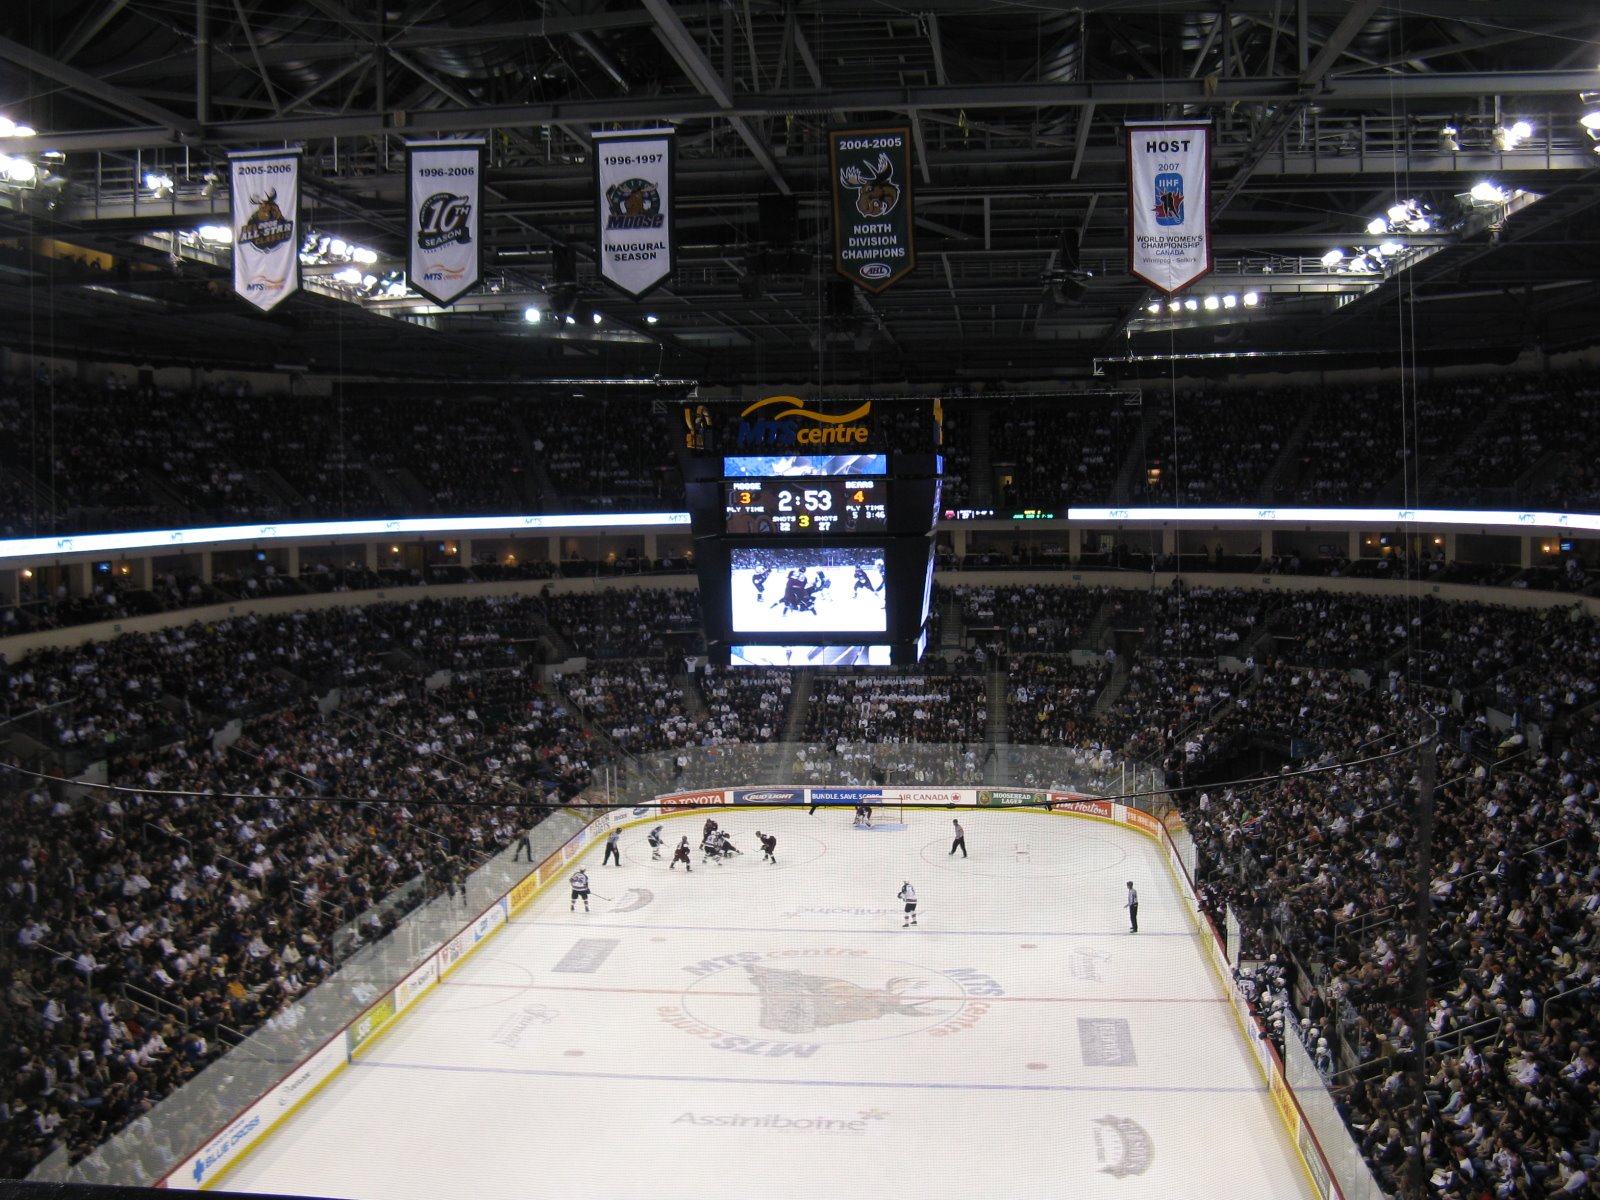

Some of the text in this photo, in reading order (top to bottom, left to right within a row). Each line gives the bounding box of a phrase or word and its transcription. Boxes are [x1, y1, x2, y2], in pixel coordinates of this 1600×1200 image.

[839, 138, 902, 150] 2004-2005
[1146, 140, 1191, 153] HOST
[604, 154, 663, 166] 1996-1997
[238, 164, 292, 176] 2005-2006
[418, 167, 475, 178] 1996-2006
[1158, 163, 1180, 171] 2007
[1158, 179, 1179, 187] IIHF
[853, 224, 892, 234] NORTH
[424, 229, 462, 248] SEASON
[848, 235, 897, 247] DIVISION
[1136, 235, 1165, 243] WORLD
[604, 242, 666, 252] INAUGURAL
[1141, 241, 1201, 249] CHAMPIONSHIP
[614, 252, 657, 261] SEASON
[841, 247, 905, 260] CHAMPIONS
[1142, 257, 1171, 265] Winnipeg
[423, 273, 443, 281] MTS
[246, 283, 265, 291] MTS
[737, 420, 869, 445] MTS centre
[733, 482, 762, 490] MOOSE
[740, 492, 751, 504] 3
[778, 490, 832, 511] 2:53
[853, 490, 865, 503] 4
[852, 511, 859, 519] 5
[1109, 510, 1129, 518] MTS
[1258, 510, 1276, 518] MTS
[798, 515, 810, 527] 3
[678, 795, 722, 806] TOYOTA
[992, 792, 1032, 800] MOOSEHEAD
[1074, 802, 1108, 816] Hortons
[671, 1112, 868, 1131] Assiniboine
